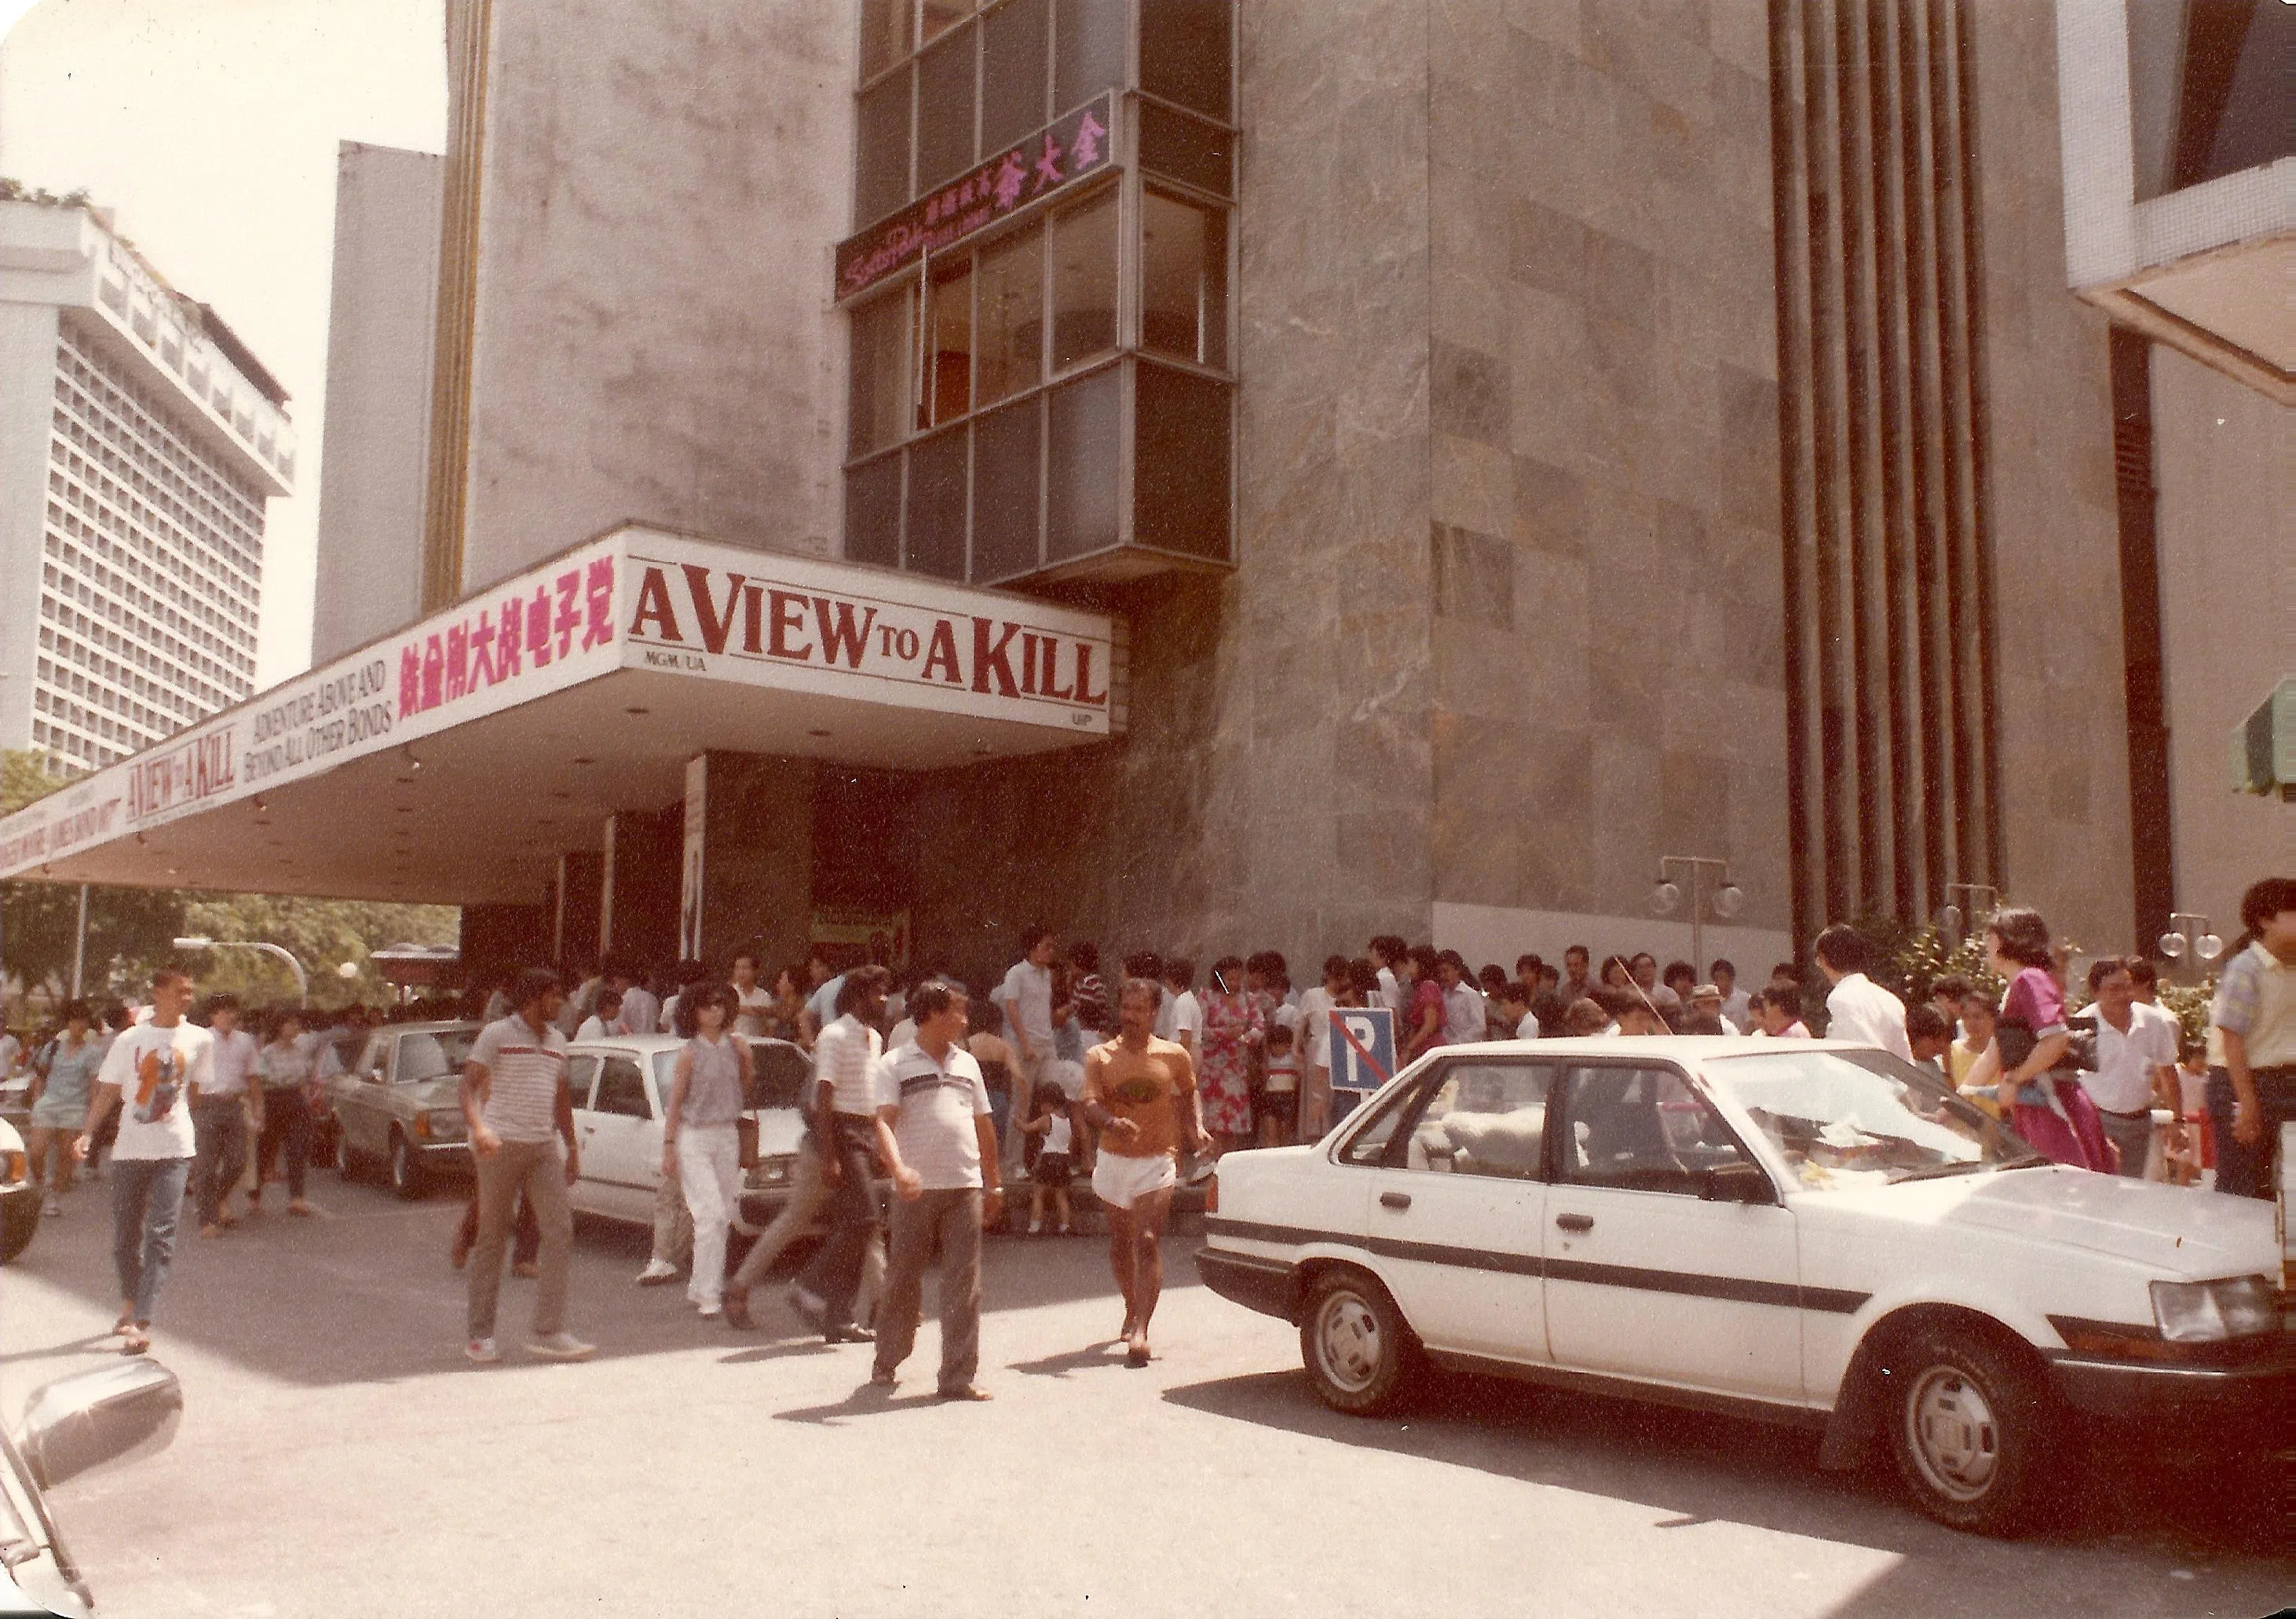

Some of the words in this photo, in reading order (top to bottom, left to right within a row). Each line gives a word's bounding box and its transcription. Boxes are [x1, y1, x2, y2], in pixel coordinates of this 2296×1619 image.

[627, 566, 683, 641] A
[680, 563, 878, 669] VIEW
[876, 624, 919, 660] TO
[920, 619, 963, 683] A
[971, 616, 1107, 705] KILL
[358, 659, 386, 697] AND
[306, 718, 346, 759] OTHER
[347, 700, 393, 744] BONDS
[195, 731, 234, 799] KILL
[1346, 1017, 1375, 1082] P
